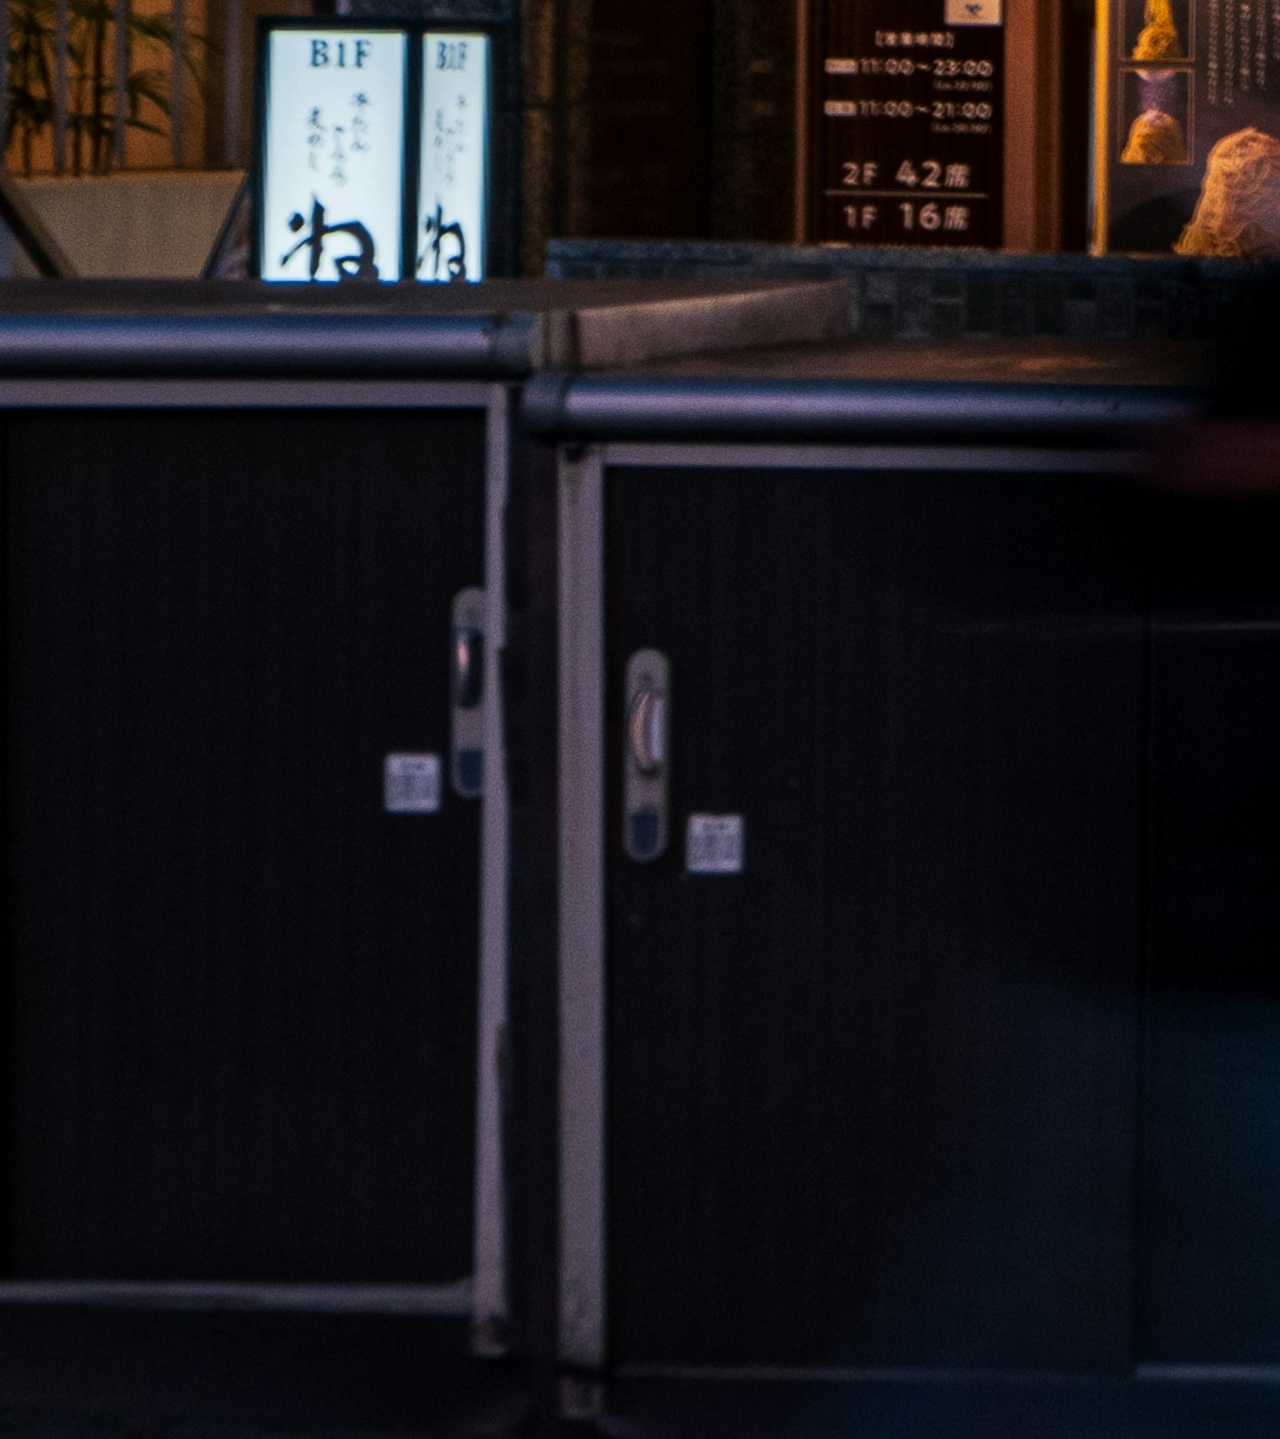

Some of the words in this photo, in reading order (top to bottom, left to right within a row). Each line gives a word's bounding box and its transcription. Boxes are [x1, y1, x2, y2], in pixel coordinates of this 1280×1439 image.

[309, 39, 371, 68] B1F
[842, 162, 879, 185] 2F
[844, 206, 878, 230] 1F
